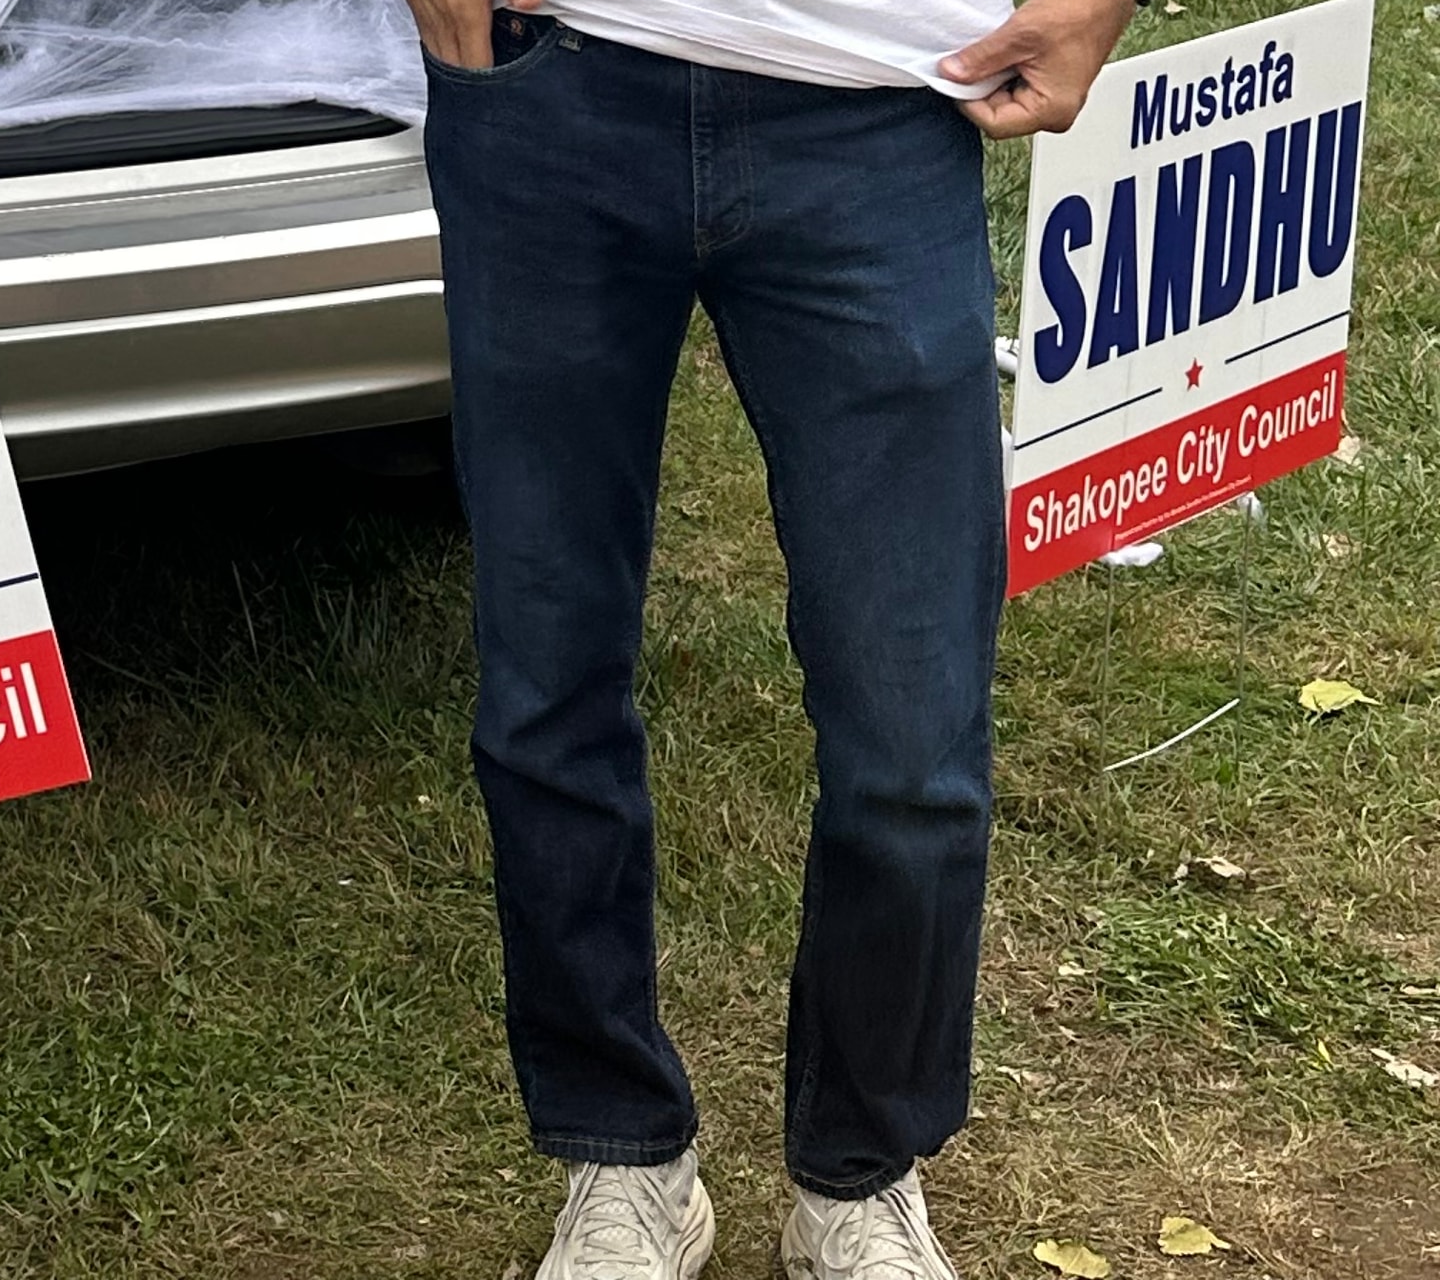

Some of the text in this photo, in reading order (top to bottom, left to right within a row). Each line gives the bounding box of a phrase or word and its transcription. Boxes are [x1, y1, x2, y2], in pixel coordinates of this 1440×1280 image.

[1130, 40, 1294, 150] Mustafa
[1033, 100, 1362, 384] SANDHU
[1024, 455, 1168, 552] Shakopee
[1177, 428, 1231, 484] City
[1238, 369, 1337, 457] Council
